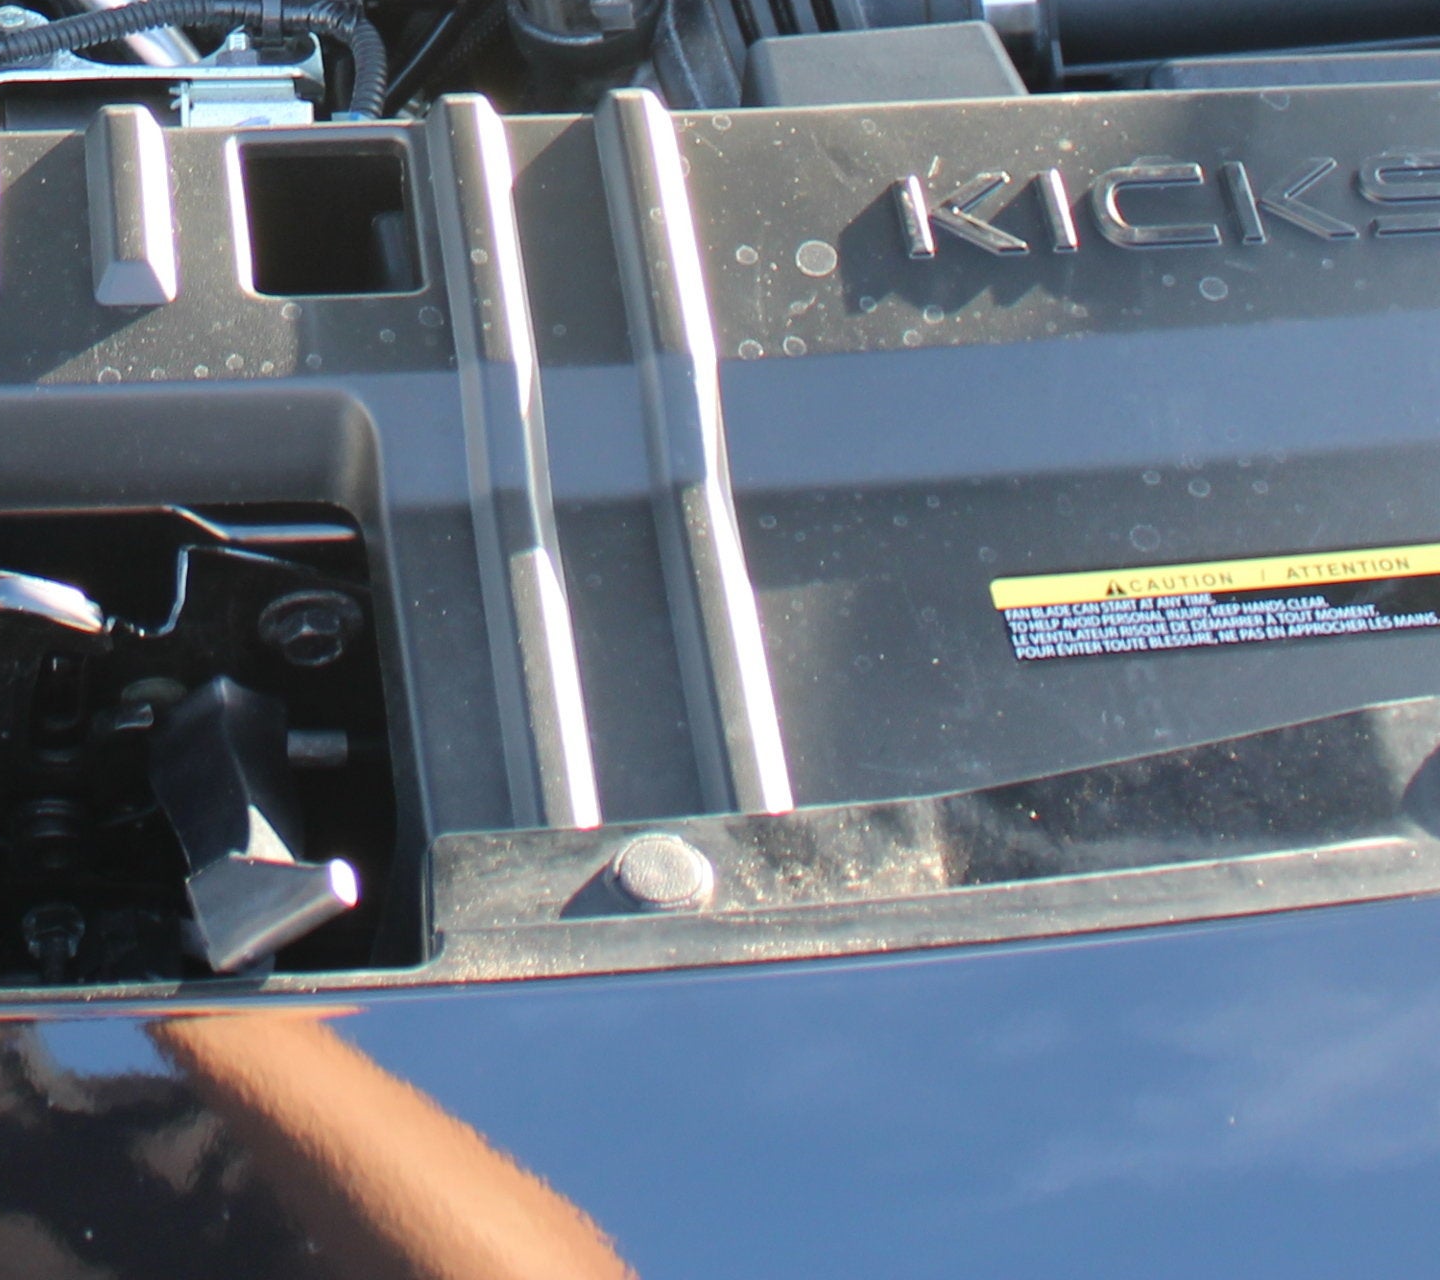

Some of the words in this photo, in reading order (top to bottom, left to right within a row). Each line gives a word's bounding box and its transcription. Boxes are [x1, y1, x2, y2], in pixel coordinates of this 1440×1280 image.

[1129, 572, 1233, 593] CAUTION
[1286, 558, 1410, 580] ATTENTION
[1005, 608, 1030, 621] FAN
[1030, 605, 1070, 619] BLADE
[1072, 602, 1099, 616] CAN
[1100, 598, 1137, 614] START
[1139, 597, 1155, 610] AT
[1156, 595, 1181, 609] ANY
[1182, 593, 1216, 607] TIME.
[1009, 620, 1028, 633] TO
[1028, 618, 1060, 632] HELP
[1062, 615, 1100, 630] AVOID
[1101, 610, 1165, 627] PERSONAL
[1211, 602, 1240, 617] KEEP
[1241, 599, 1286, 614] HANDS
[1287, 595, 1330, 610] CLEAR.
[1012, 634, 1029, 647] LE
[1029, 625, 1119, 645] VENTILATEUR
[1120, 620, 1168, 637] RISQUE
[1170, 619, 1189, 632] DE
[1278, 608, 1313, 623] TOUT
[1314, 603, 1380, 622] MOMENT.
[1016, 644, 1055, 660] POUR
[1104, 636, 1148, 652] TOUTE
[1218, 630, 1239, 643] NE
[1240, 627, 1265, 641] PAS
[1266, 624, 1285, 638] EN
[1287, 618, 1366, 637] APPROCHER
[1369, 614, 1392, 630] LES
